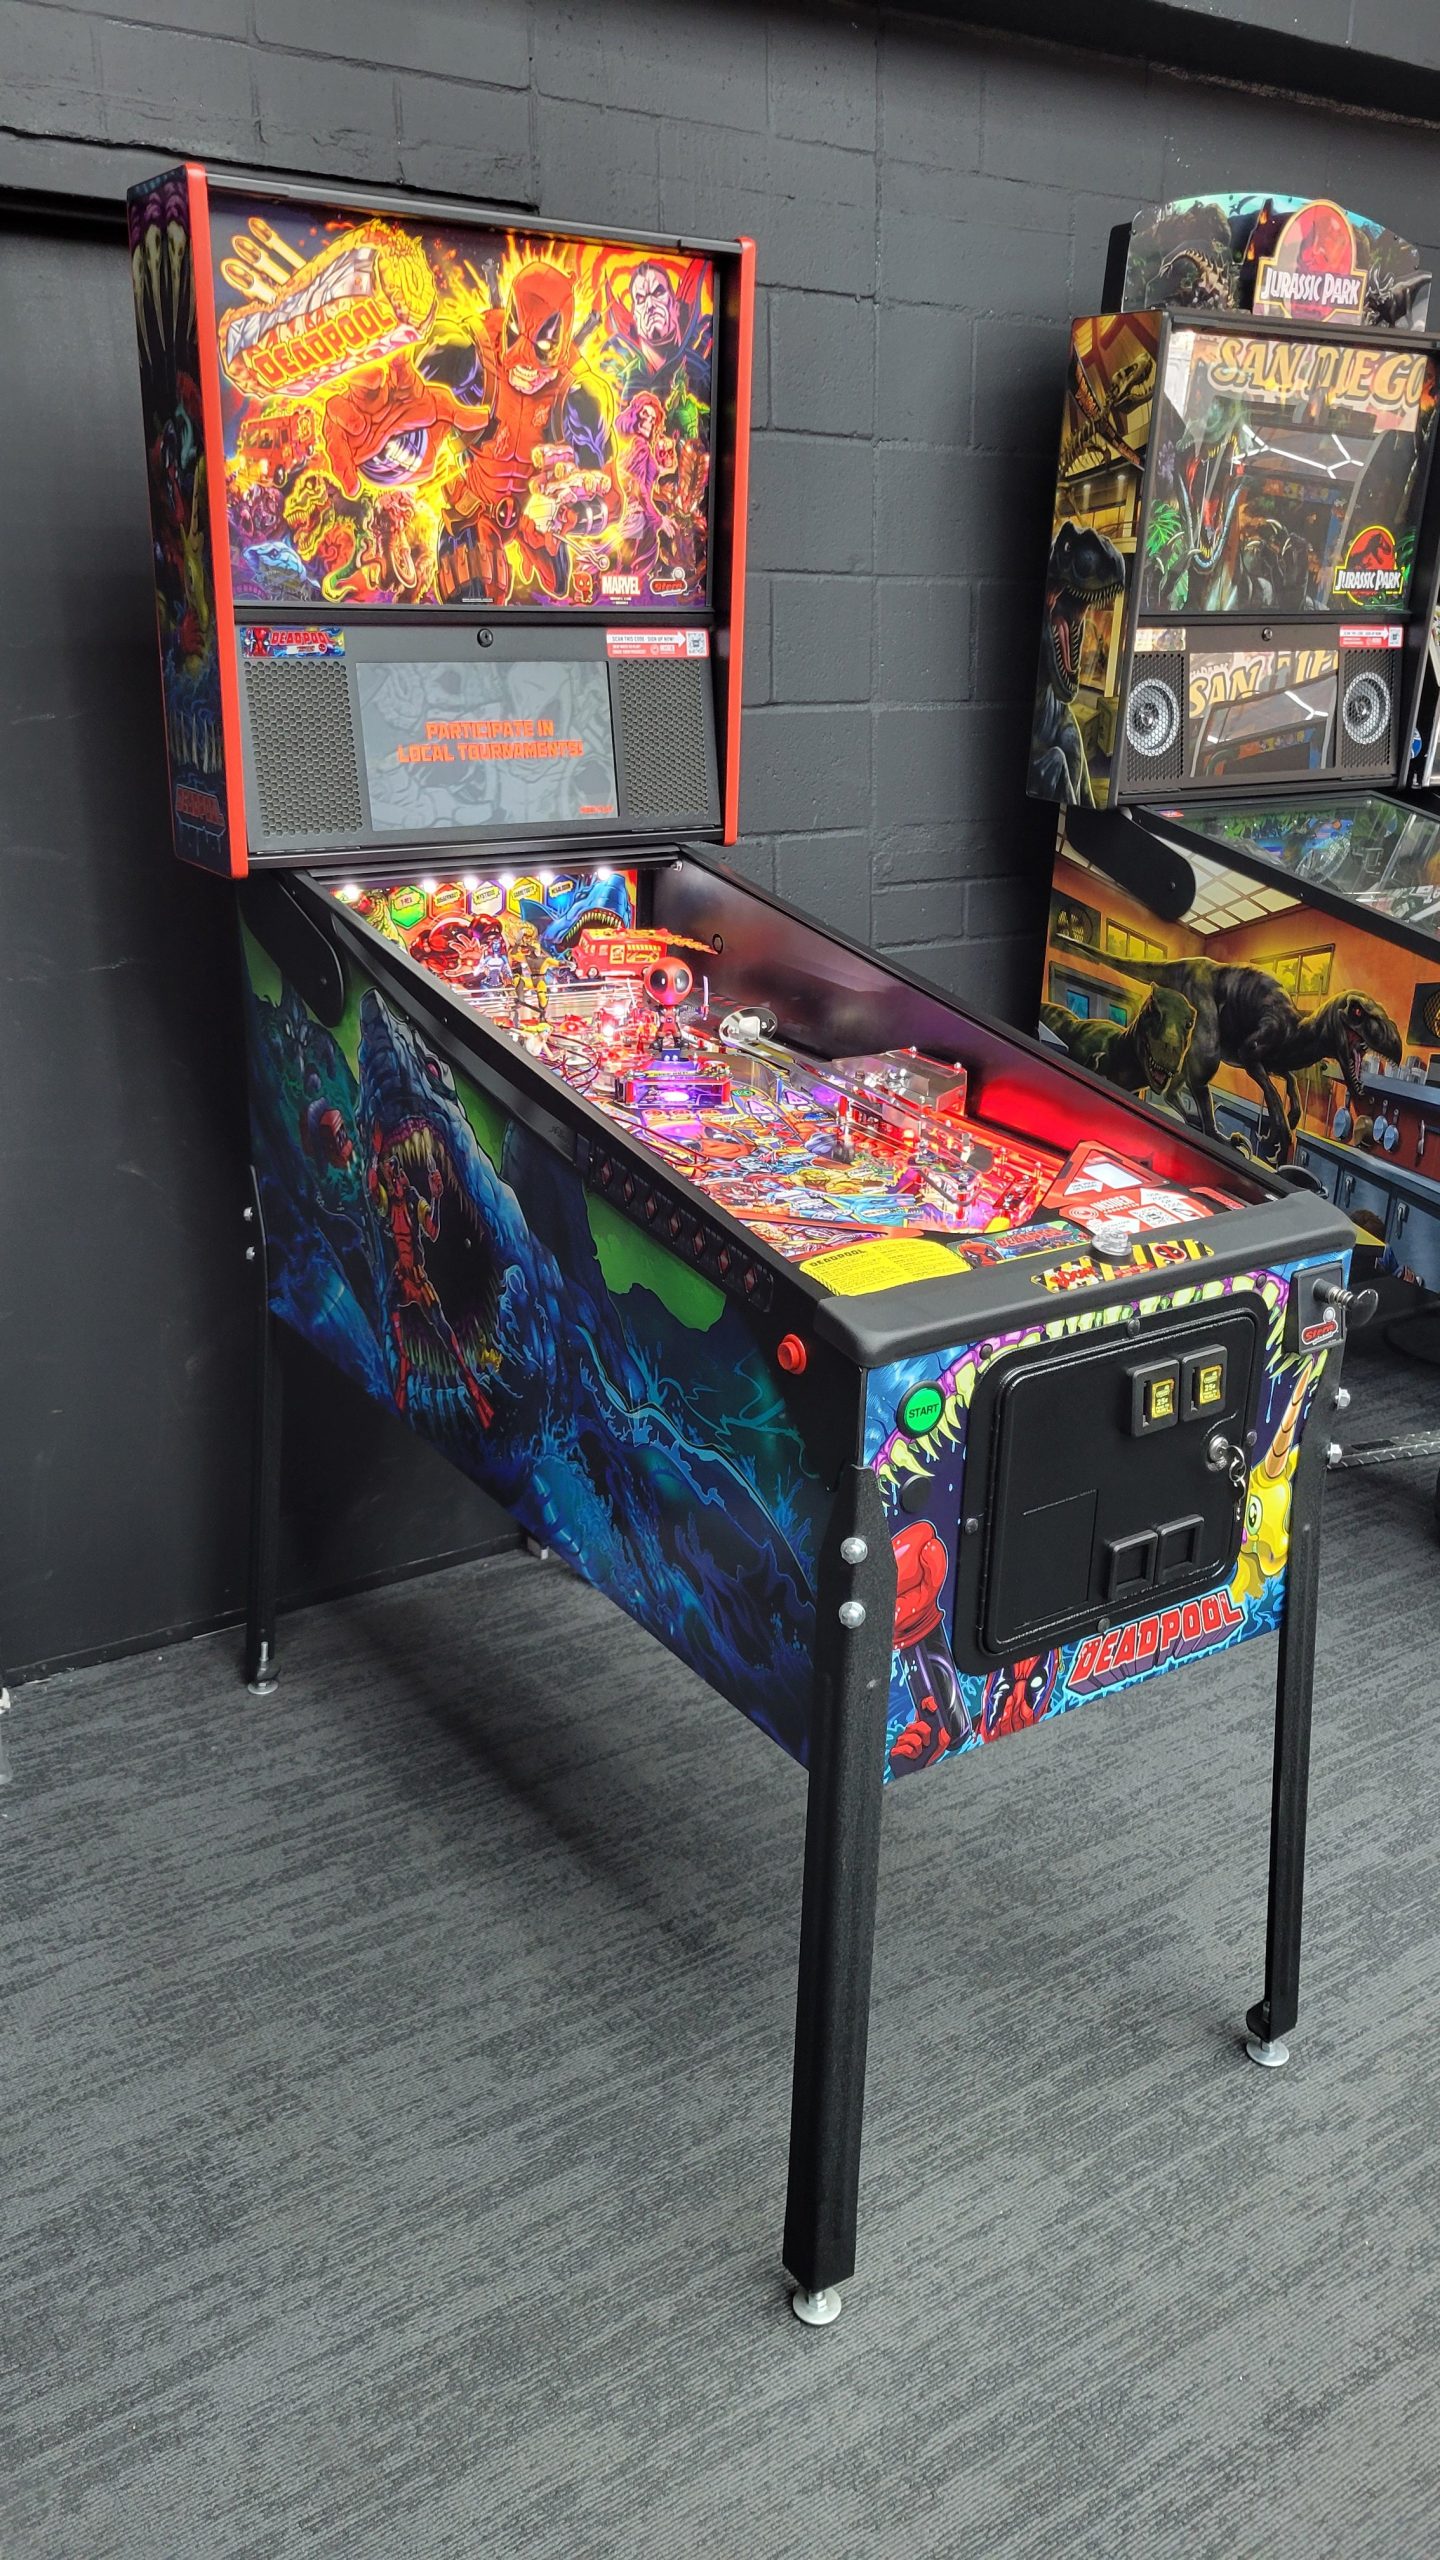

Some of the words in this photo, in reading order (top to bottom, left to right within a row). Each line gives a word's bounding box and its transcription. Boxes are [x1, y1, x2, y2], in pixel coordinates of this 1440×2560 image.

[1260, 266, 1322, 302] JURASSIC
[1321, 272, 1361, 305] PARK
[252, 299, 398, 387] DEADPOOL
[1212, 338, 1305, 391] SAN
[601, 575, 641, 595] MARVEL
[1334, 570, 1376, 591] JURASSIC
[1374, 569, 1402, 591] PARK
[270, 631, 337, 645] DEADPOOL
[425, 720, 533, 740] PARTICIPATE
[537, 720, 554, 737] IN
[397, 744, 455, 763] LOCAL
[457, 740, 584, 761] TOURNAMENTS!
[994, 1228, 1073, 1248] DEADPOOL
[809, 1248, 867, 1267] DEADPOOL
[1304, 1324, 1335, 1341] Stern
[908, 1403, 940, 1419] START
[1066, 1590, 1244, 1687] DEADPOOL
